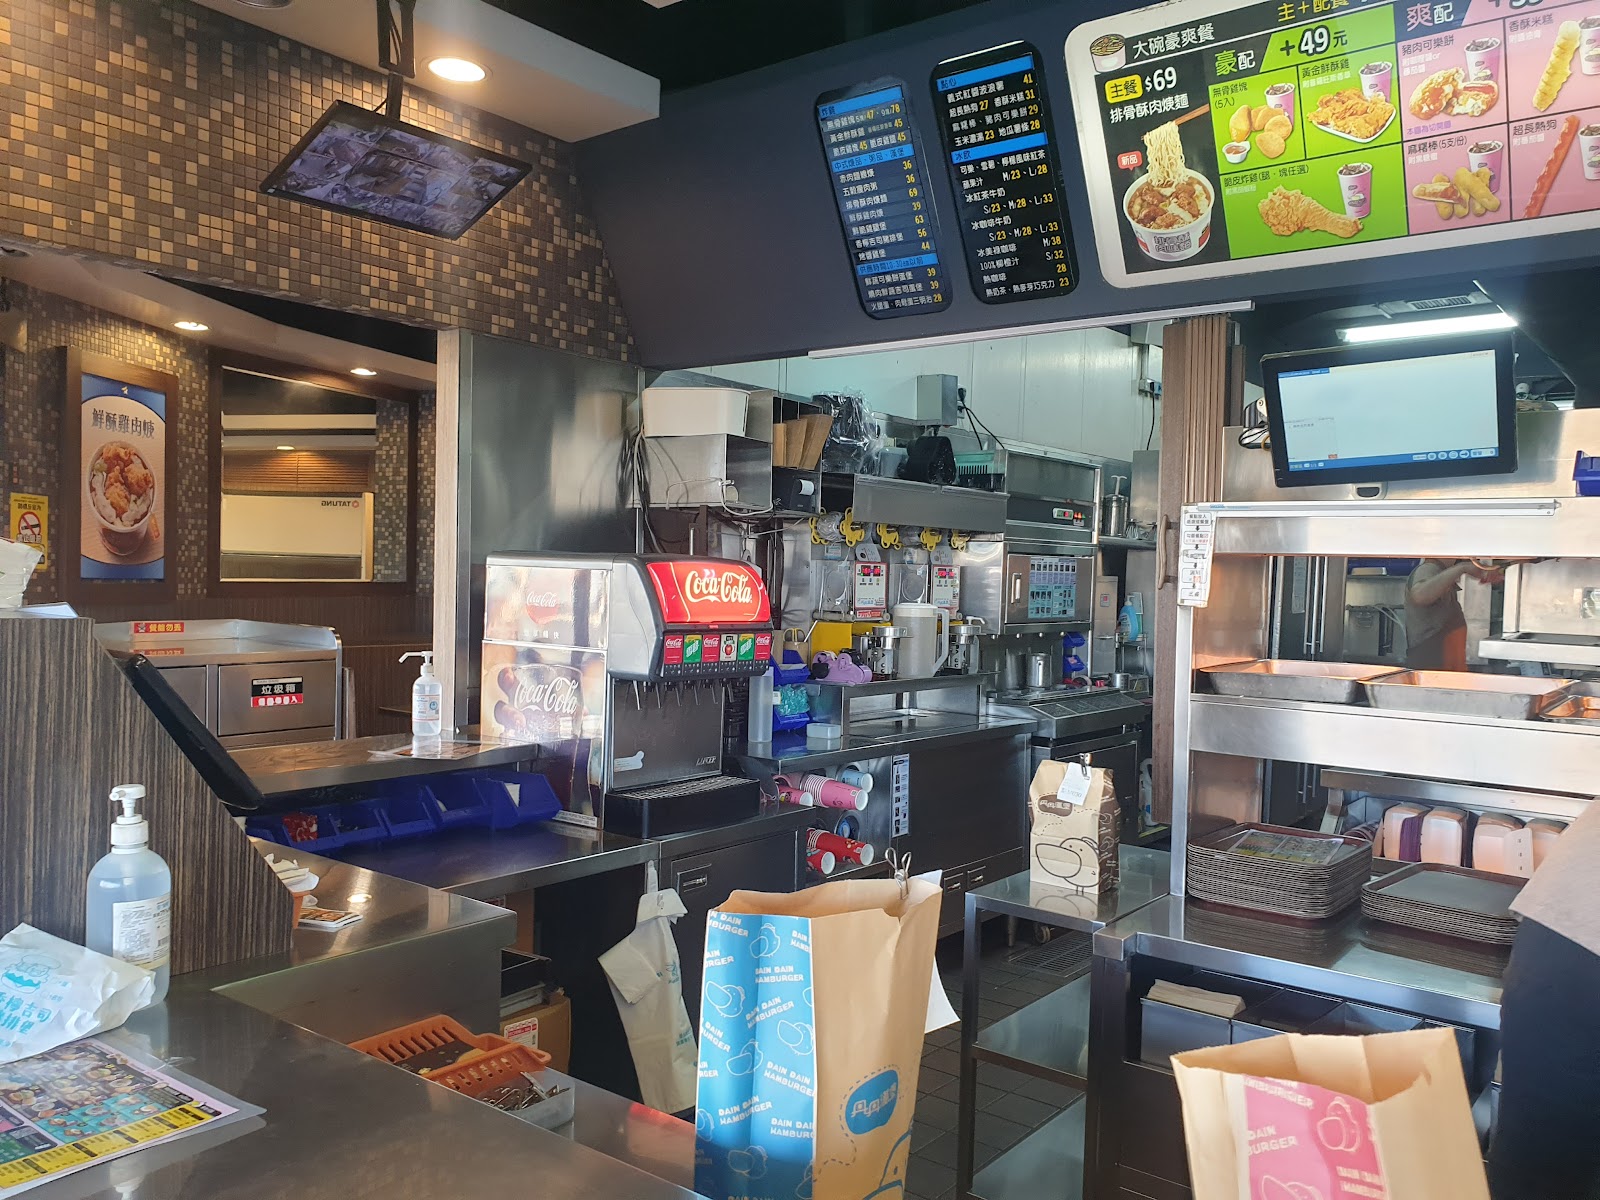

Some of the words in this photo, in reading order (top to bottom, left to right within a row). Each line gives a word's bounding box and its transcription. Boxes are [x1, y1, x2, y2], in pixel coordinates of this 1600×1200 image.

[1407, 2, 1454, 32] 爽配
[1509, 14, 1554, 32] 香酥米糕
[1133, 23, 1215, 59] 大碗豪爽餐
[1402, 35, 1454, 56] 豬肉可樂餅
[1215, 49, 1256, 75] 豪配
[1302, 59, 1349, 78] 黃金鮮酥雞
[1023, 74, 1033, 84] 41
[1145, 66, 1177, 92] $69
[1110, 79, 1138, 99] 主餐
[1213, 82, 1248, 97] 無骨雞塊
[980, 100, 988, 110] 27
[1025, 89, 1035, 100] 31
[1214, 97, 1234, 110] (5入)
[1028, 105, 1038, 115] 29
[894, 119, 903, 128] 45
[1513, 120, 1557, 136] 超長熱狗
[985, 130, 994, 140] 23
[1030, 120, 1040, 130] 28
[860, 141, 868, 150] 45
[897, 132, 906, 141] 45
[903, 160, 912, 170] 36
[906, 174, 914, 183] 36
[909, 188, 917, 197] 69
[912, 202, 921, 210] 39
[915, 215, 924, 224] 63
[918, 228, 927, 237] 56
[921, 242, 930, 250] 44
[927, 268, 936, 276] 39
[1057, 264, 1066, 273] 28
[930, 281, 938, 289] 39
[1059, 278, 1069, 286] 23
[933, 294, 942, 302] 28
[685, 571, 752, 603] Coca-Cola
[261, 684, 296, 694] 垃圾箱
[720, 913, 742, 925] DAIN
[762, 996, 781, 1008] DAIN
[705, 1022, 723, 1038] DAIN
[767, 1061, 787, 1075] DAIN
[790, 1070, 810, 1085] DAIN
[718, 1105, 740, 1116] DAIN
[720, 1102, 773, 1125] HAMBURGER
[772, 1118, 792, 1128] DAIN
